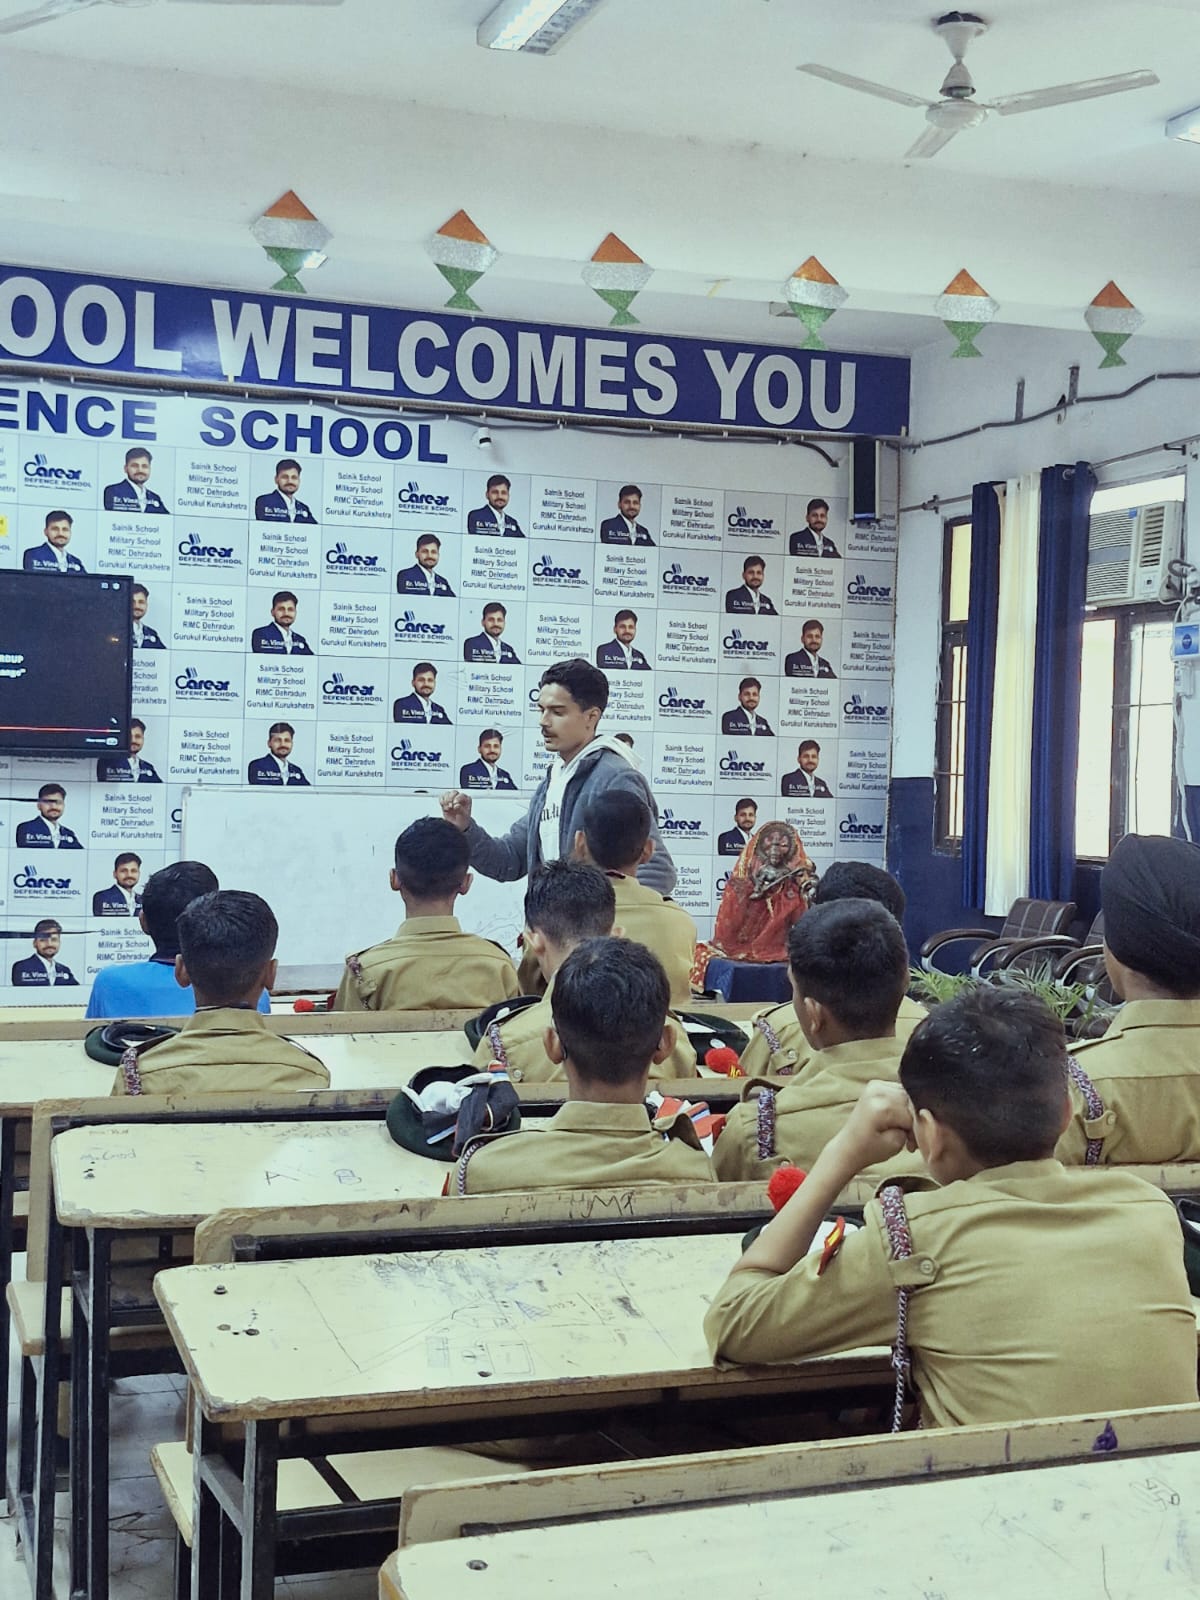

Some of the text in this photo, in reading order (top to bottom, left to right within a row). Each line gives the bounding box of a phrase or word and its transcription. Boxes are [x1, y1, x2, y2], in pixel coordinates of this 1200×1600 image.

[212, 298, 678, 415] WELCOMES
[703, 348, 857, 430] YOU
[199, 406, 449, 464] SCHOOL
[191, 462, 236, 472] Sainik School
[189, 474, 238, 484] Military School
[207, 488, 239, 497] Dehradun
[178, 498, 204, 507] Gurukul
[112, 523, 159, 533] Sainik School
[110, 536, 134, 545] Military
[108, 548, 162, 558] RIMC Dehradun
[99, 560, 125, 568] Gurukul
[187, 596, 206, 604] Sainik
[185, 609, 234, 618] Military School
[332, 615, 354, 624] Military
[203, 622, 235, 630] Dehradun
[174, 633, 200, 641] Gurukul
[321, 638, 346, 646] Gurukul
[260, 664, 304, 673] Sainik School
[258, 677, 281, 685] Military
[275, 689, 306, 697] Dehradun
[247, 700, 272, 708] Gurukul
[181, 742, 205, 751] Military
[328, 746, 350, 754] Military
[170, 766, 196, 774] Gurukul
[103, 806, 127, 815] Military
